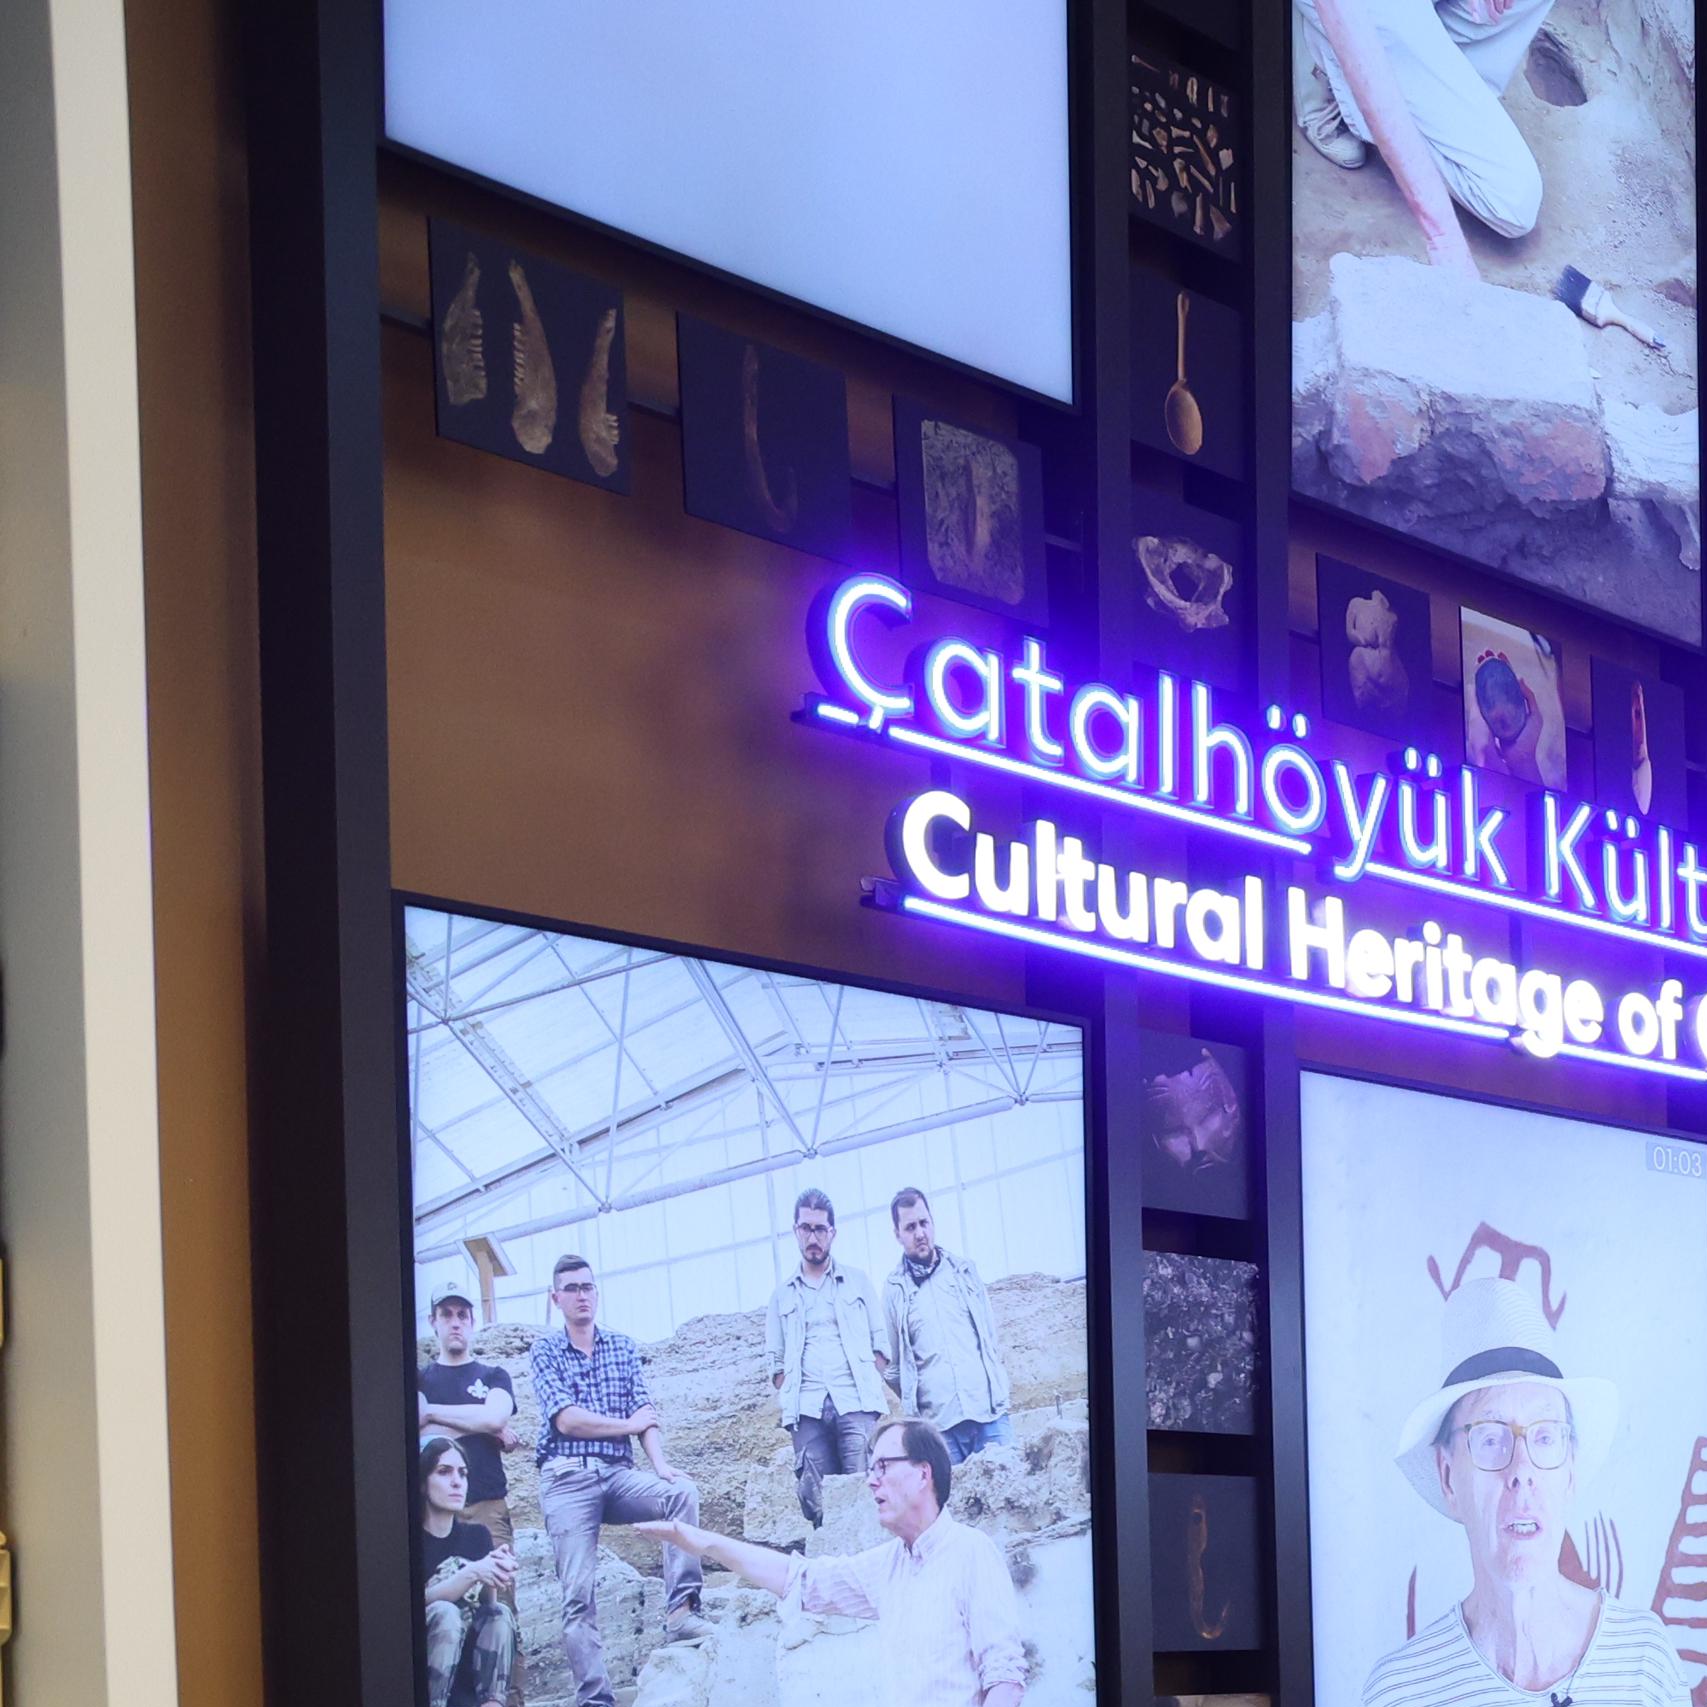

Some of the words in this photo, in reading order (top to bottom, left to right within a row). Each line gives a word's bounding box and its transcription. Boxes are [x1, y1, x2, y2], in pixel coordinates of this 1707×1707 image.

[822, 572, 1513, 880] Çatalhöyük
[897, 790, 1264, 974] Cultural
[1286, 883, 1604, 1060] Heritage
[1619, 980, 1684, 1059] of
[1653, 1145, 1702, 1177] 01:03
